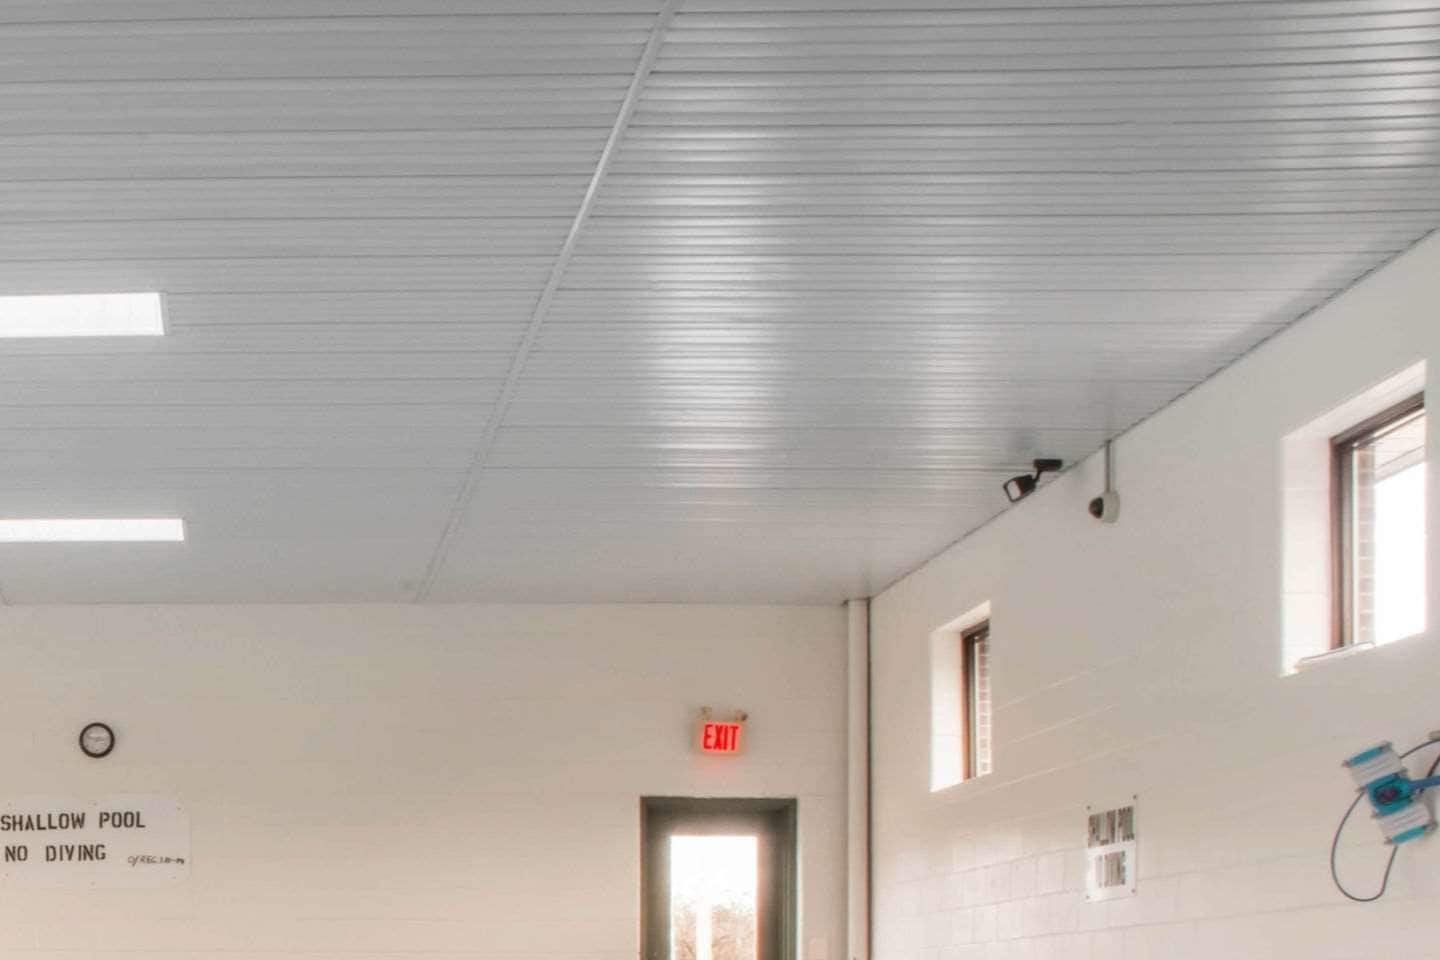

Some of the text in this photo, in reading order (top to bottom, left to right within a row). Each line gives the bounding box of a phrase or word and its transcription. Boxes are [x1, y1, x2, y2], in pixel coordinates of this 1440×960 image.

[703, 724, 739, 751] EXIT
[0, 811, 146, 832] SHALLOW POOL
[4, 844, 107, 862] NO DIVING
